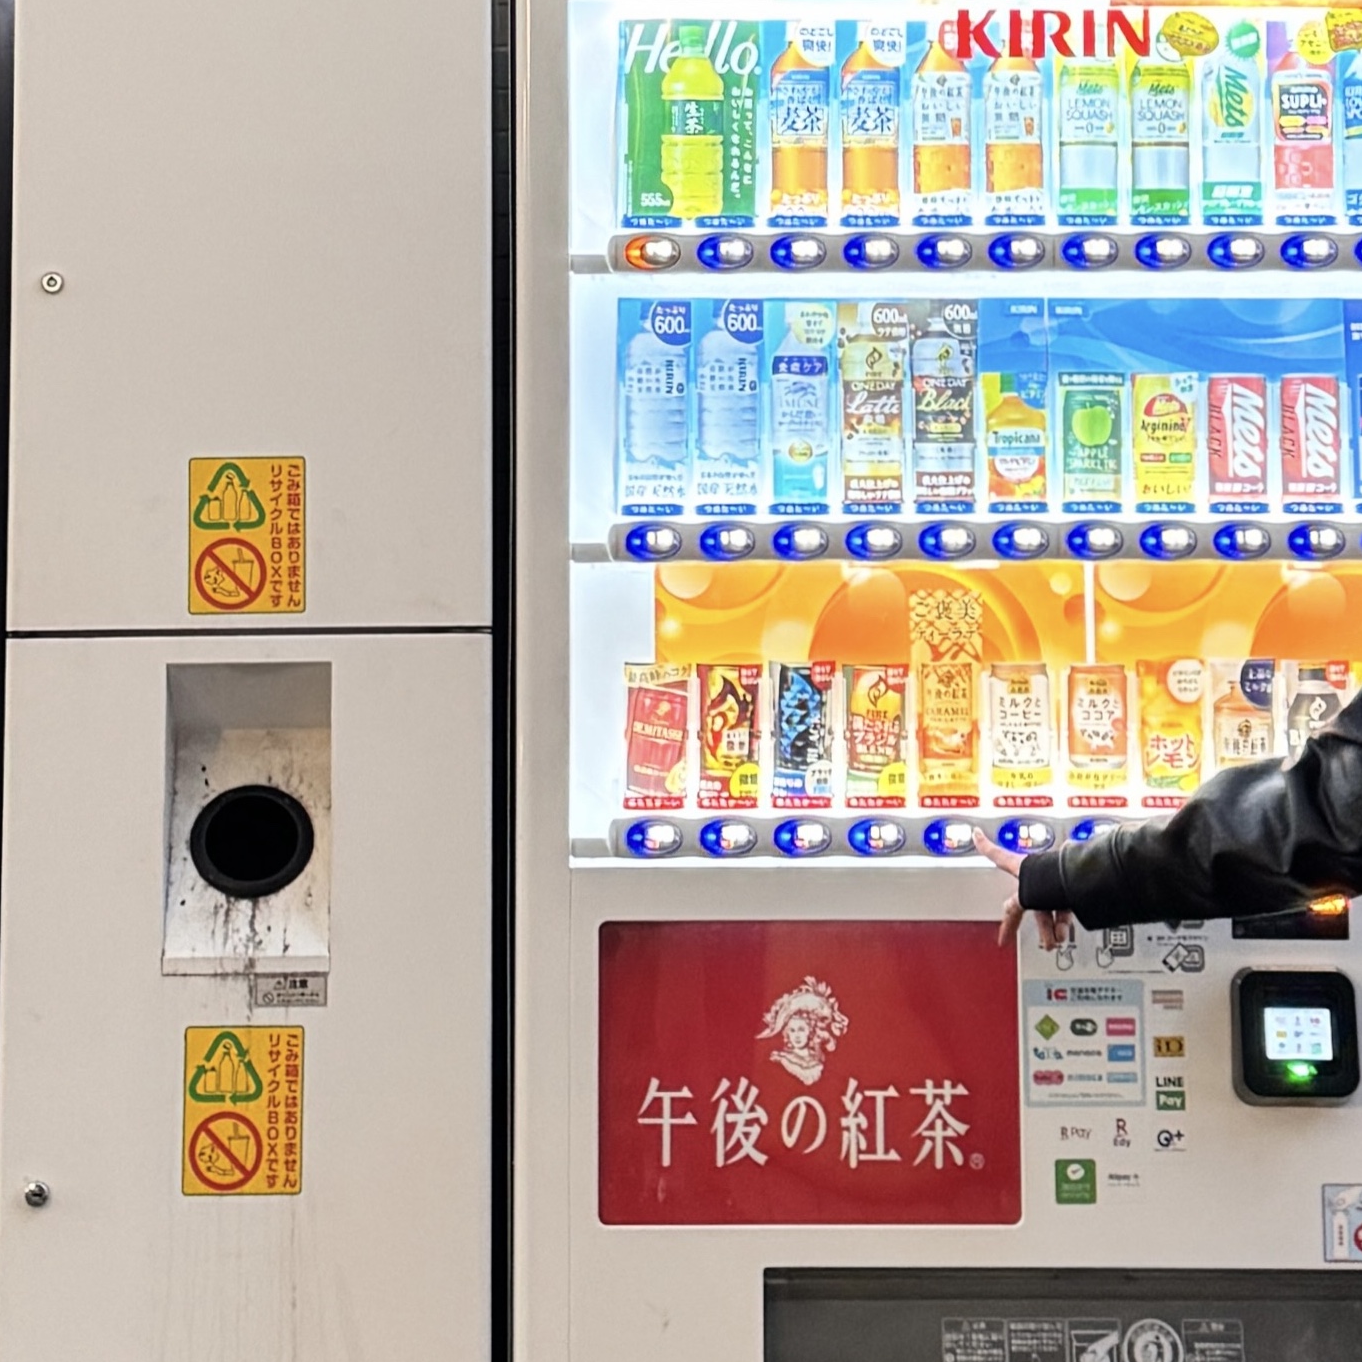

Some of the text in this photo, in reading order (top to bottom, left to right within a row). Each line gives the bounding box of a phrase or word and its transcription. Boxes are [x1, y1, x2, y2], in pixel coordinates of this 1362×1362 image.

[957, 8, 1151, 59] KIRIN
[1068, 97, 1110, 109] LEMON
[1140, 97, 1182, 109] LEMON
[1215, 64, 1248, 128] Mets
[684, 100, 704, 134] 生茶
[781, 106, 822, 134] 麦茶
[852, 106, 893, 134] 麦茶
[993, 431, 1041, 445] Tropicana
[269, 463, 284, 608] リサイクルBOXです
[914, 598, 976, 621] ご褒美
[919, 627, 977, 641] ティーラテ
[999, 697, 1042, 709] ミルクと
[999, 710, 1042, 720] コーヒー
[1150, 733, 1194, 751] ホット
[1146, 750, 1200, 768] レモン
[1155, 1076, 1184, 1088] LINE
[1158, 1094, 1183, 1107] Pay
[266, 1033, 281, 1189] リサイクルBOXです
[636, 1075, 971, 1171] 午後の紅茶
[1113, 1136, 1131, 1148] Edy
